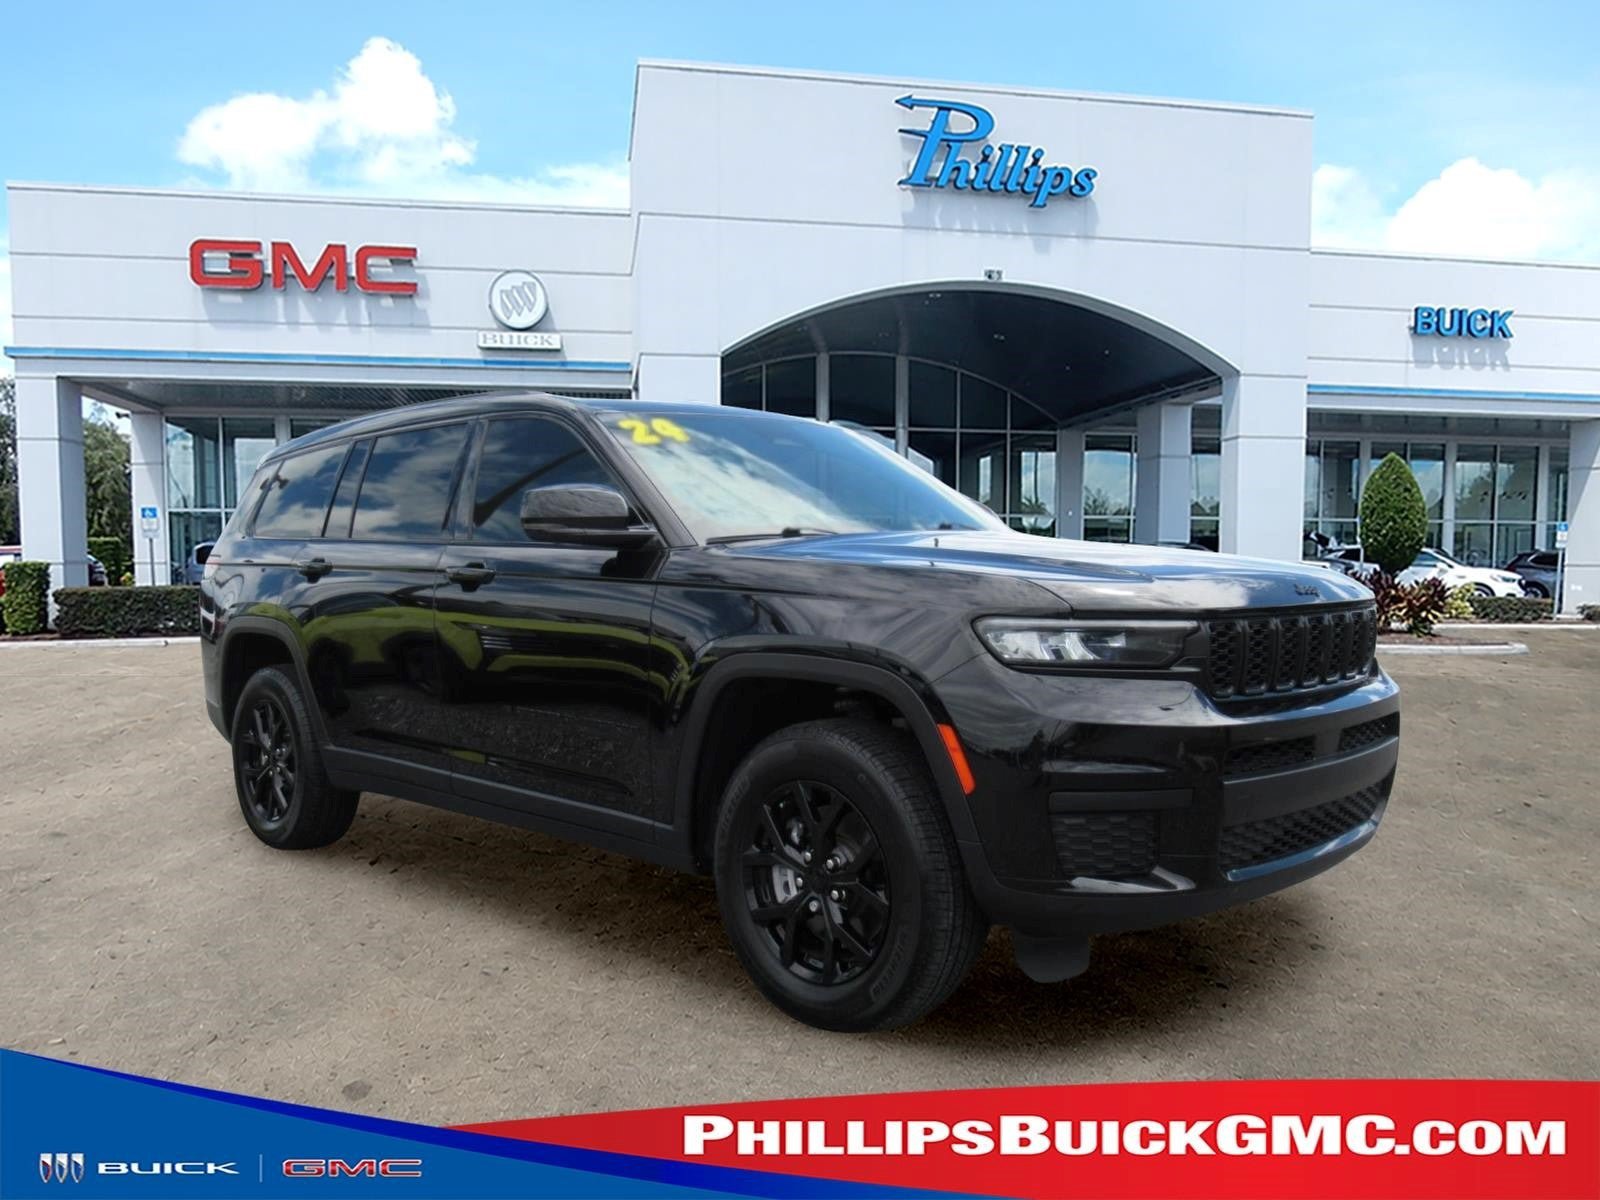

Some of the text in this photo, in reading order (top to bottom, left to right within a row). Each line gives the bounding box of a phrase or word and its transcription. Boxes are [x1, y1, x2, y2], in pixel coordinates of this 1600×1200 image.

[894, 95, 1097, 208] Phillips
[189, 239, 417, 293] GMC
[482, 333, 553, 346] BUICK
[1414, 306, 1513, 338] BUICK
